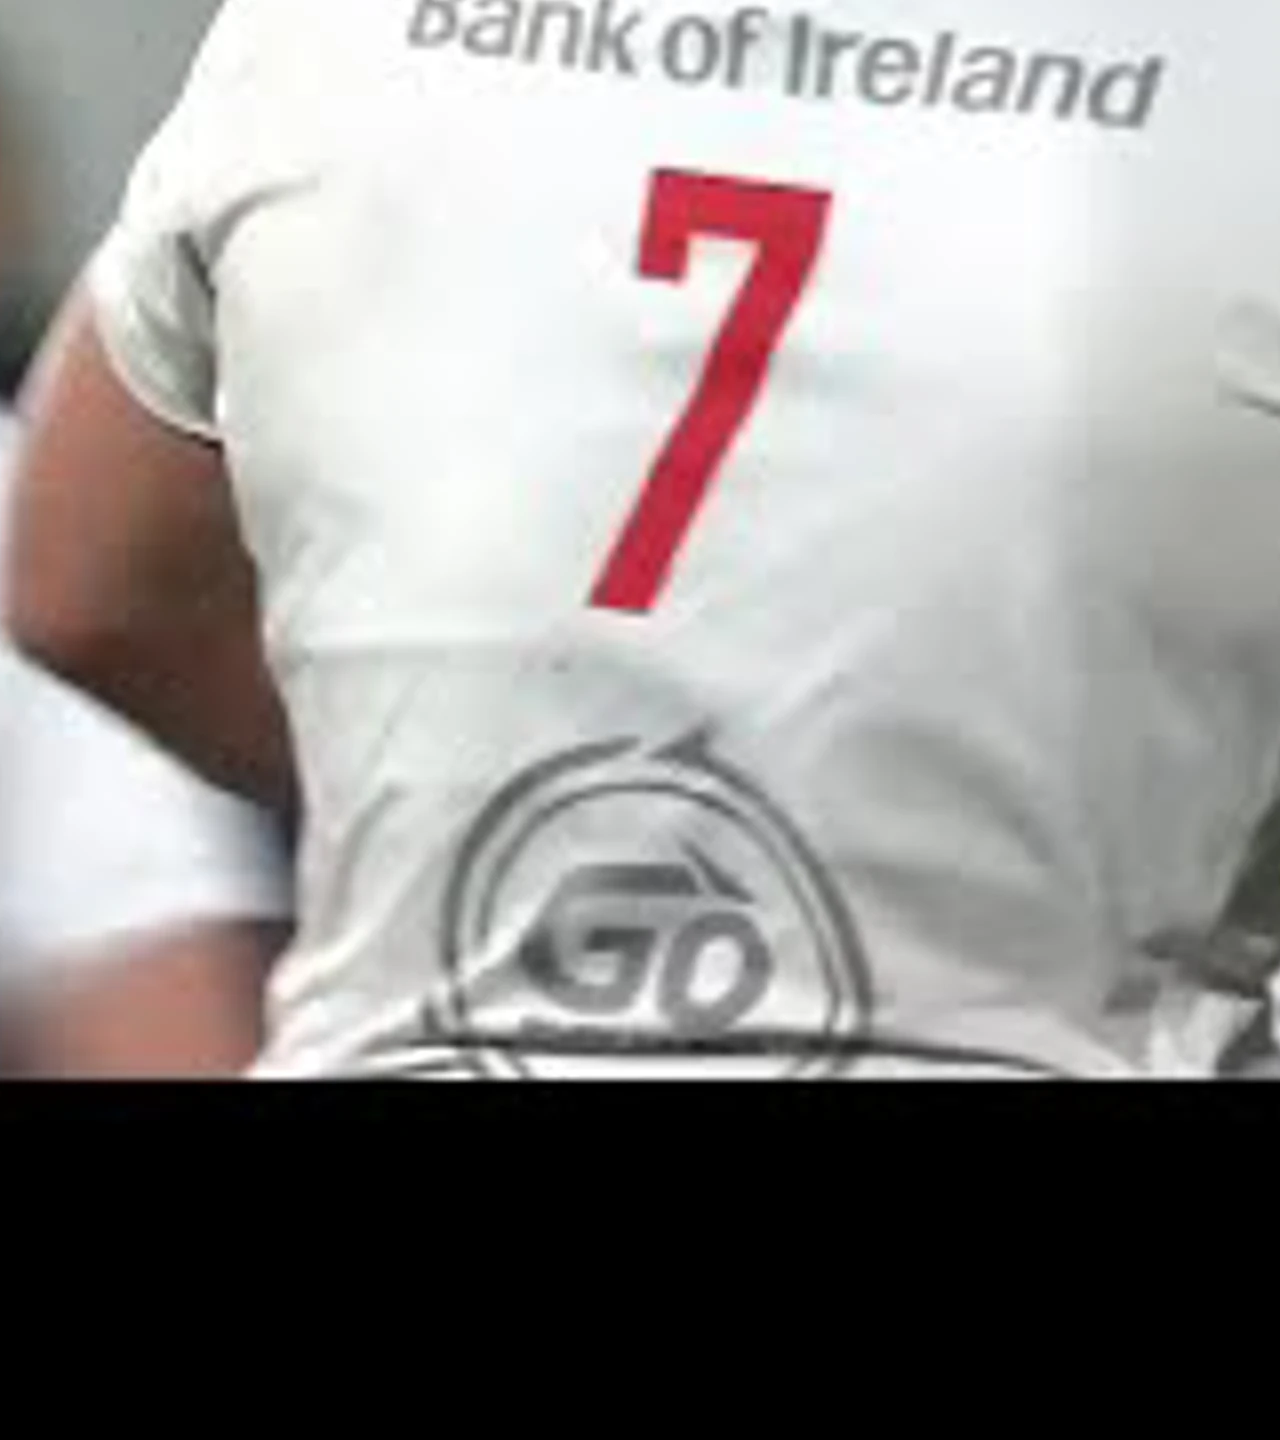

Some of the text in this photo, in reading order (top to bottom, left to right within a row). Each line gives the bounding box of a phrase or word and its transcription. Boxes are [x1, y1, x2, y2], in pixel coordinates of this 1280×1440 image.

[660, 8, 765, 88] of
[783, 12, 1165, 129] Ireland
[587, 167, 832, 613] 7
